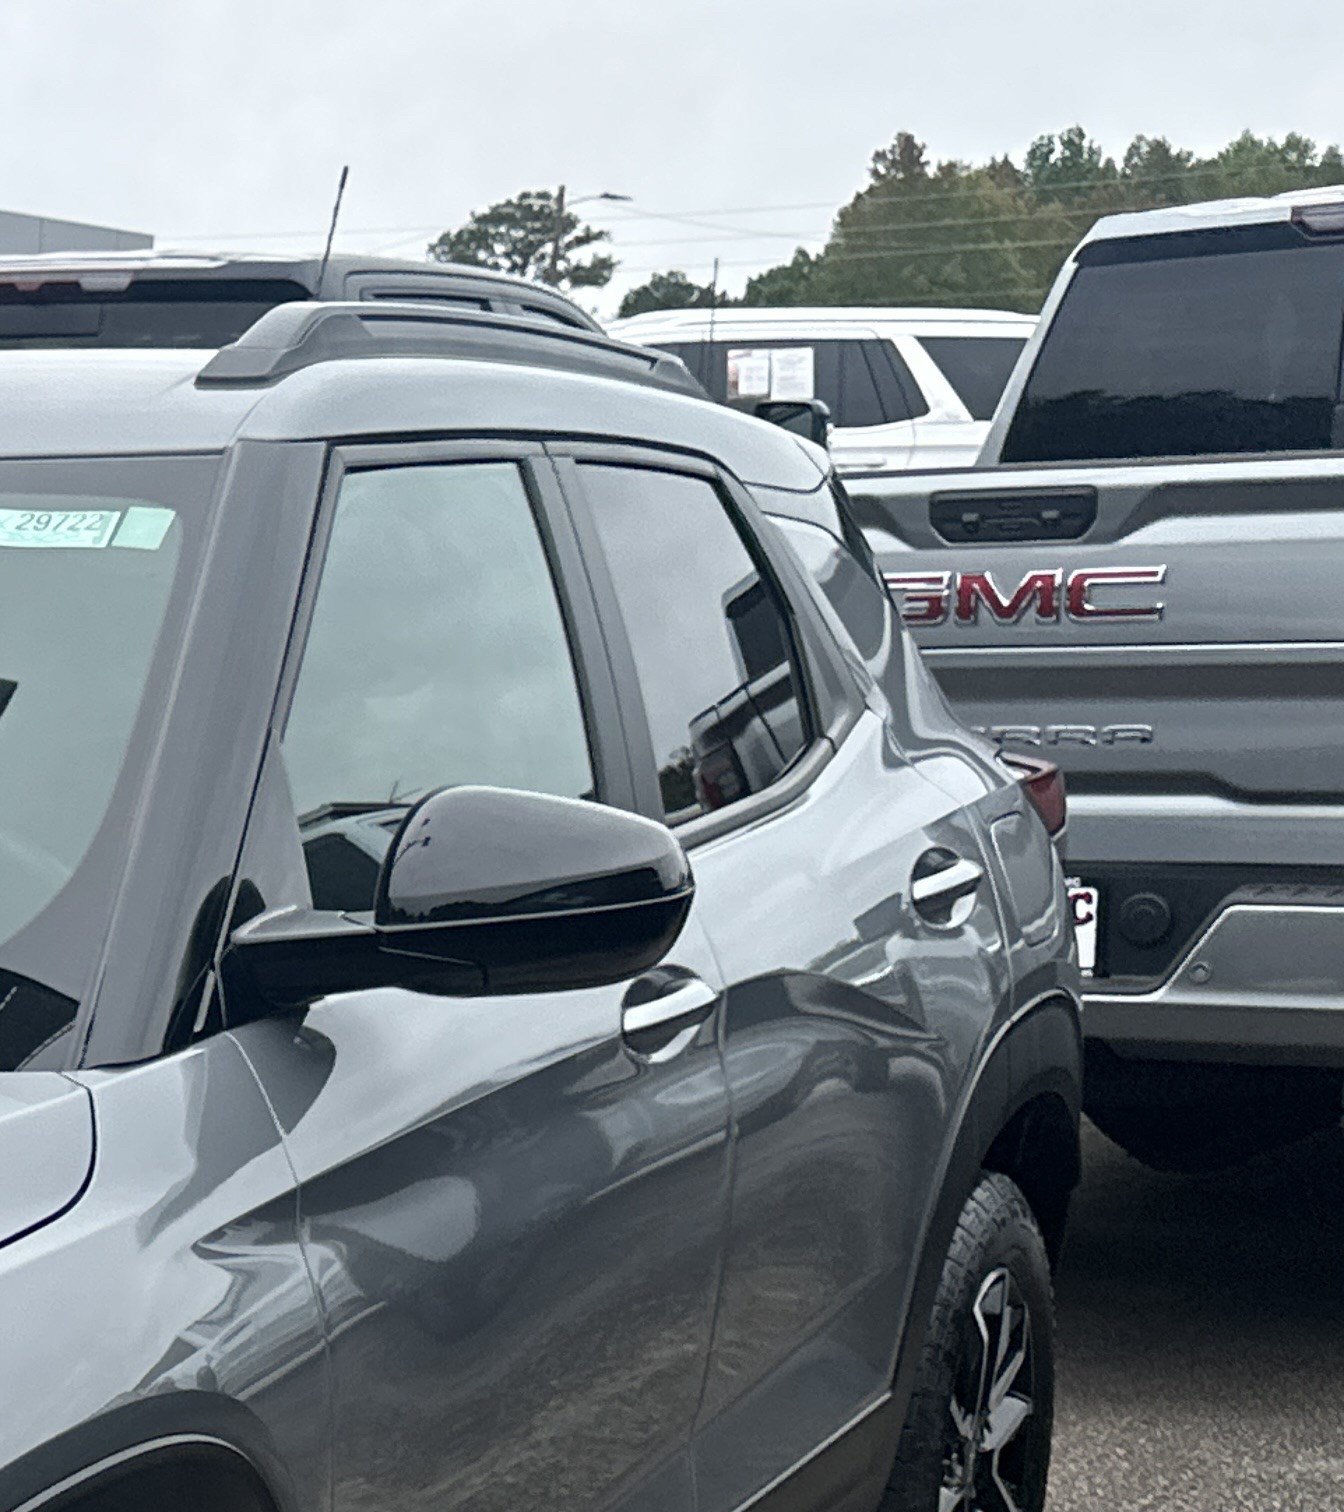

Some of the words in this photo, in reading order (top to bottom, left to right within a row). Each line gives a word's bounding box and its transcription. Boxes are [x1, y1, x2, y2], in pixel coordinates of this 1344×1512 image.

[14, 512, 104, 532] 29722
[882, 564, 1167, 626] GMC
[970, 723, 1154, 747] RRA
